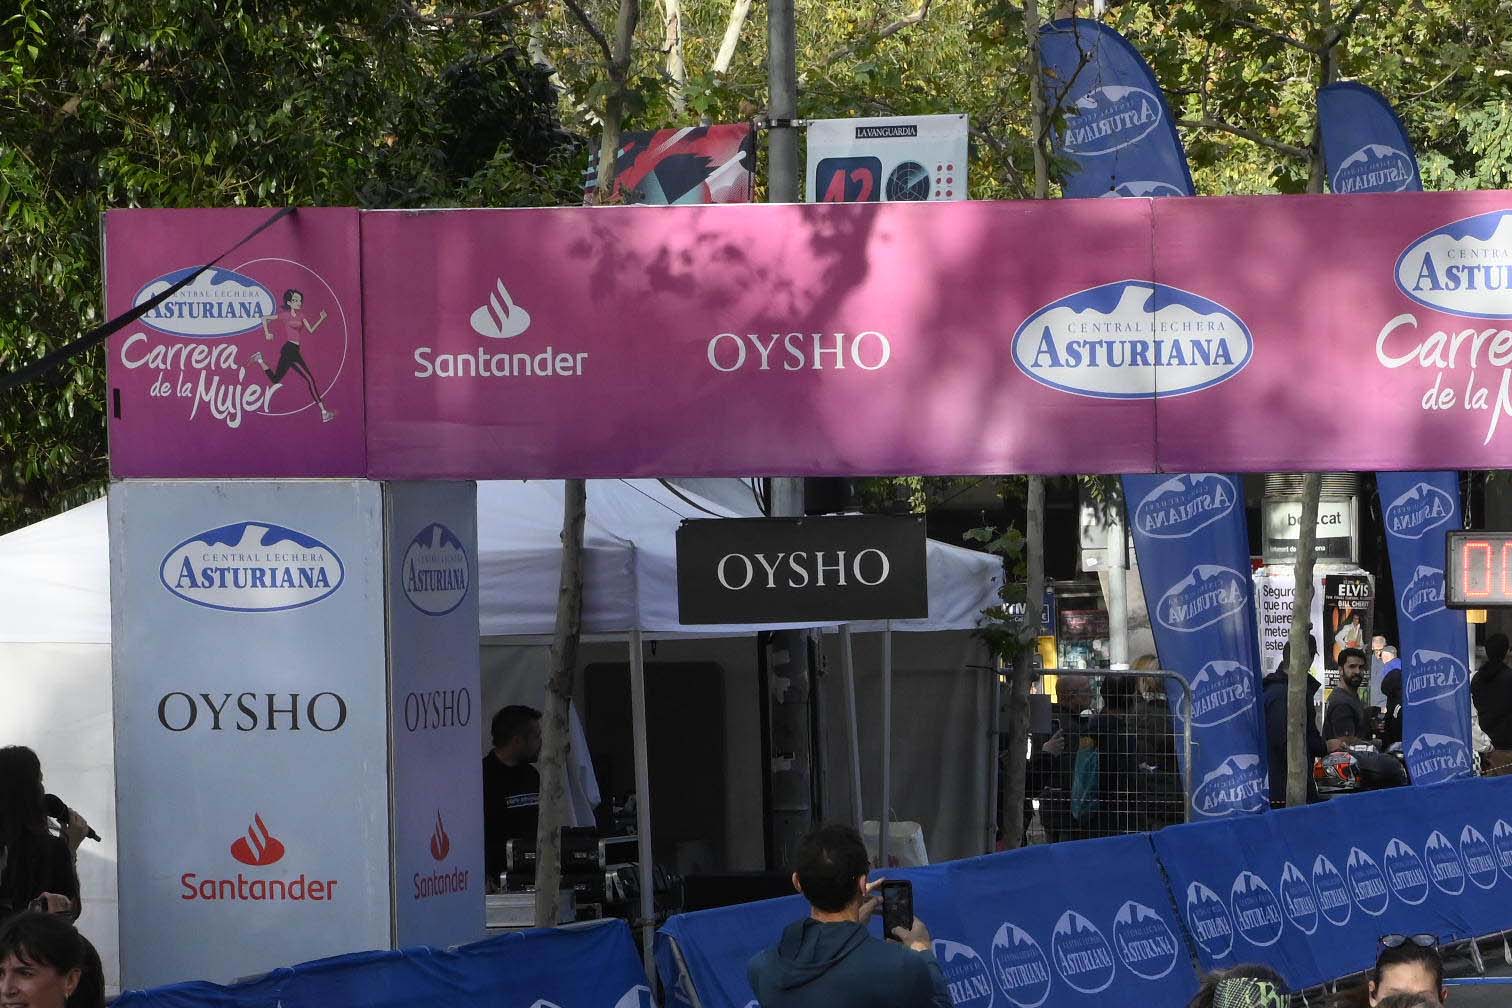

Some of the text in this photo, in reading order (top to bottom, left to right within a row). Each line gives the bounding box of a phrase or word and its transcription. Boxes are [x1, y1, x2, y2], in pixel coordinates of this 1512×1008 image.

[144, 292, 263, 319] ASTURIANA
[170, 290, 210, 298] ENTRAL
[1068, 321, 1226, 333] CENTRAL LECHERA
[121, 333, 238, 369] Carrera
[414, 346, 588, 378] Santander
[707, 331, 891, 372] OYSHO
[1031, 326, 1234, 368] ASTURIANA
[150, 367, 282, 428] de la Mujer
[1422, 372, 1456, 410] de
[1465, 372, 1488, 410] la
[175, 556, 331, 589] ASTURIANA
[203, 552, 324, 562] CENTRAL LECHERA
[717, 548, 890, 591] OYSHO
[407, 558, 465, 592] ASTURIANA
[1338, 584, 1369, 596] ELVIS
[1263, 601, 1280, 613] que
[1264, 613, 1294, 626] quiere
[158, 692, 347, 732] OYSHO
[405, 688, 471, 732] OYSHO
[181, 873, 337, 900] Santander
[414, 869, 469, 899] Santander
[997, 957, 1048, 990] ASTURIANA
[1058, 944, 1112, 976] ASTURIANA
